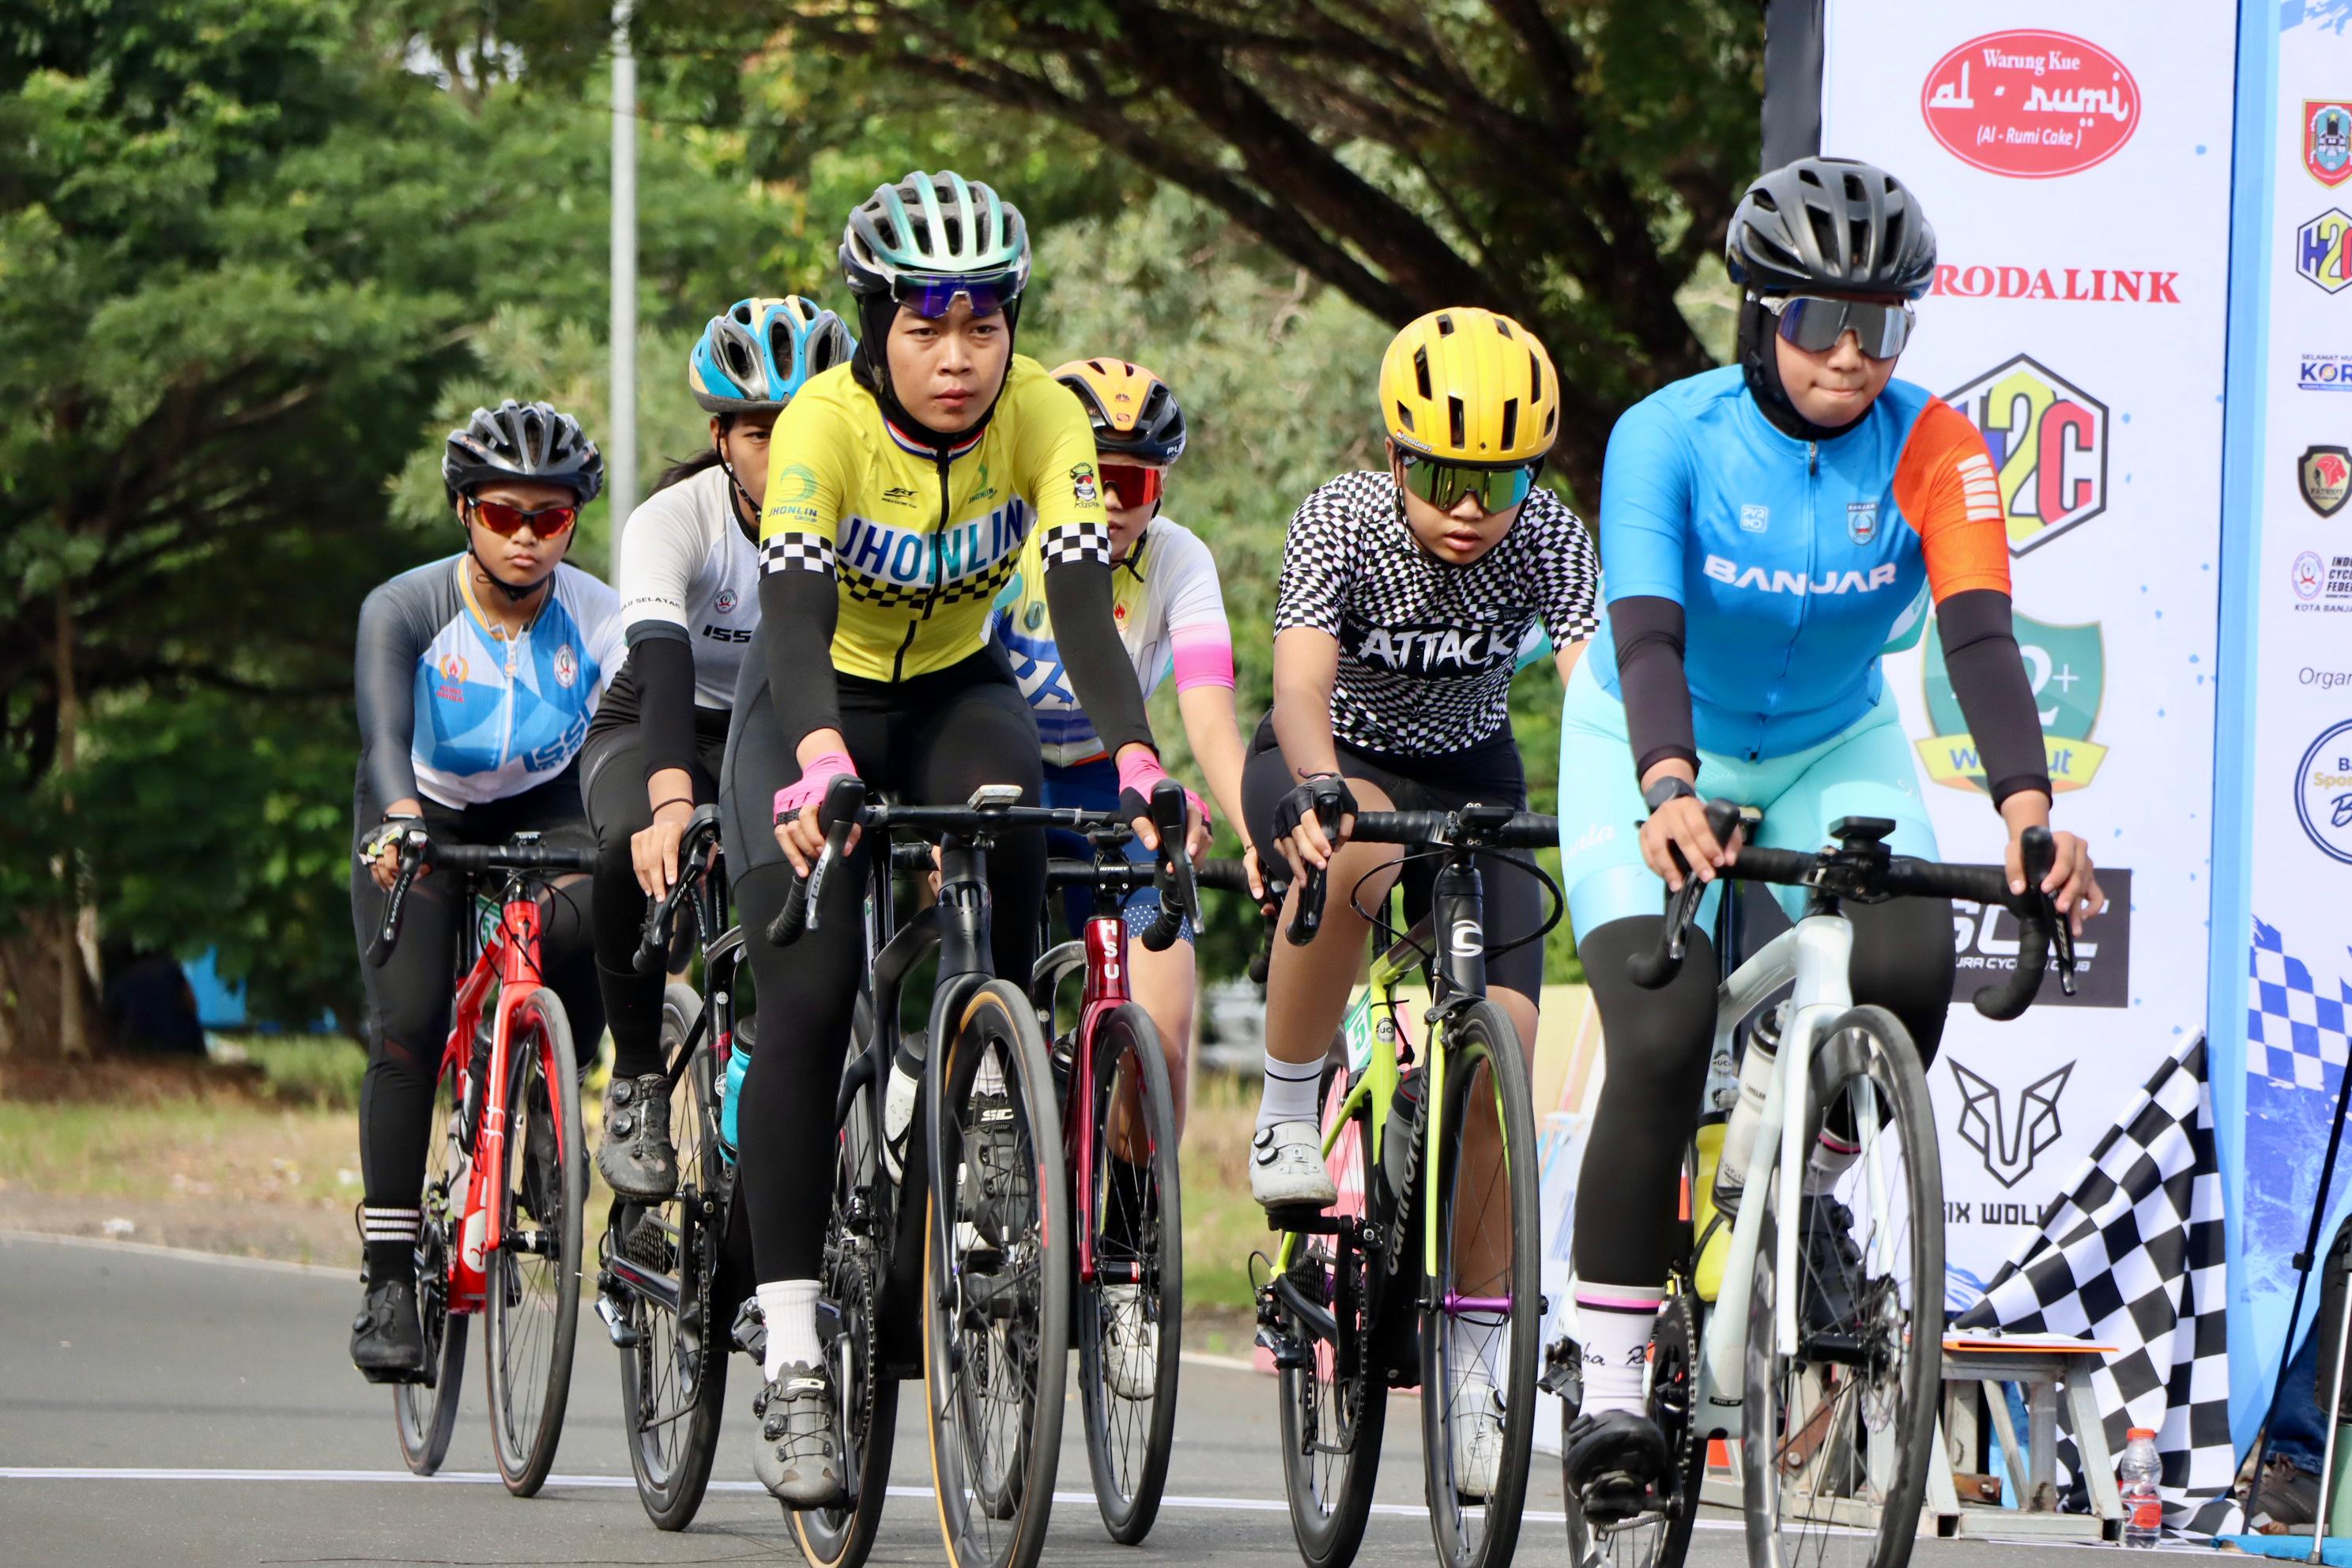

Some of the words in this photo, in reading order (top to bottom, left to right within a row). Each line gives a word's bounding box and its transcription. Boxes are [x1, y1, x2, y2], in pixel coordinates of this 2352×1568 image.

[1983, 49, 2045, 76] Warung
[2048, 51, 2081, 70] Kue
[2007, 127, 2041, 144] Rumi
[2043, 130, 2074, 145] Cake
[1930, 264, 2181, 304] RODALINK
[768, 507, 817, 517] JHONLIN
[836, 499, 1023, 584] JHONLIN
[1702, 554, 1896, 596] BANJAR
[637, 597, 681, 609] SELATAN
[1358, 628, 1517, 673] ATTACK
[1943, 1201, 1970, 1223] IX
